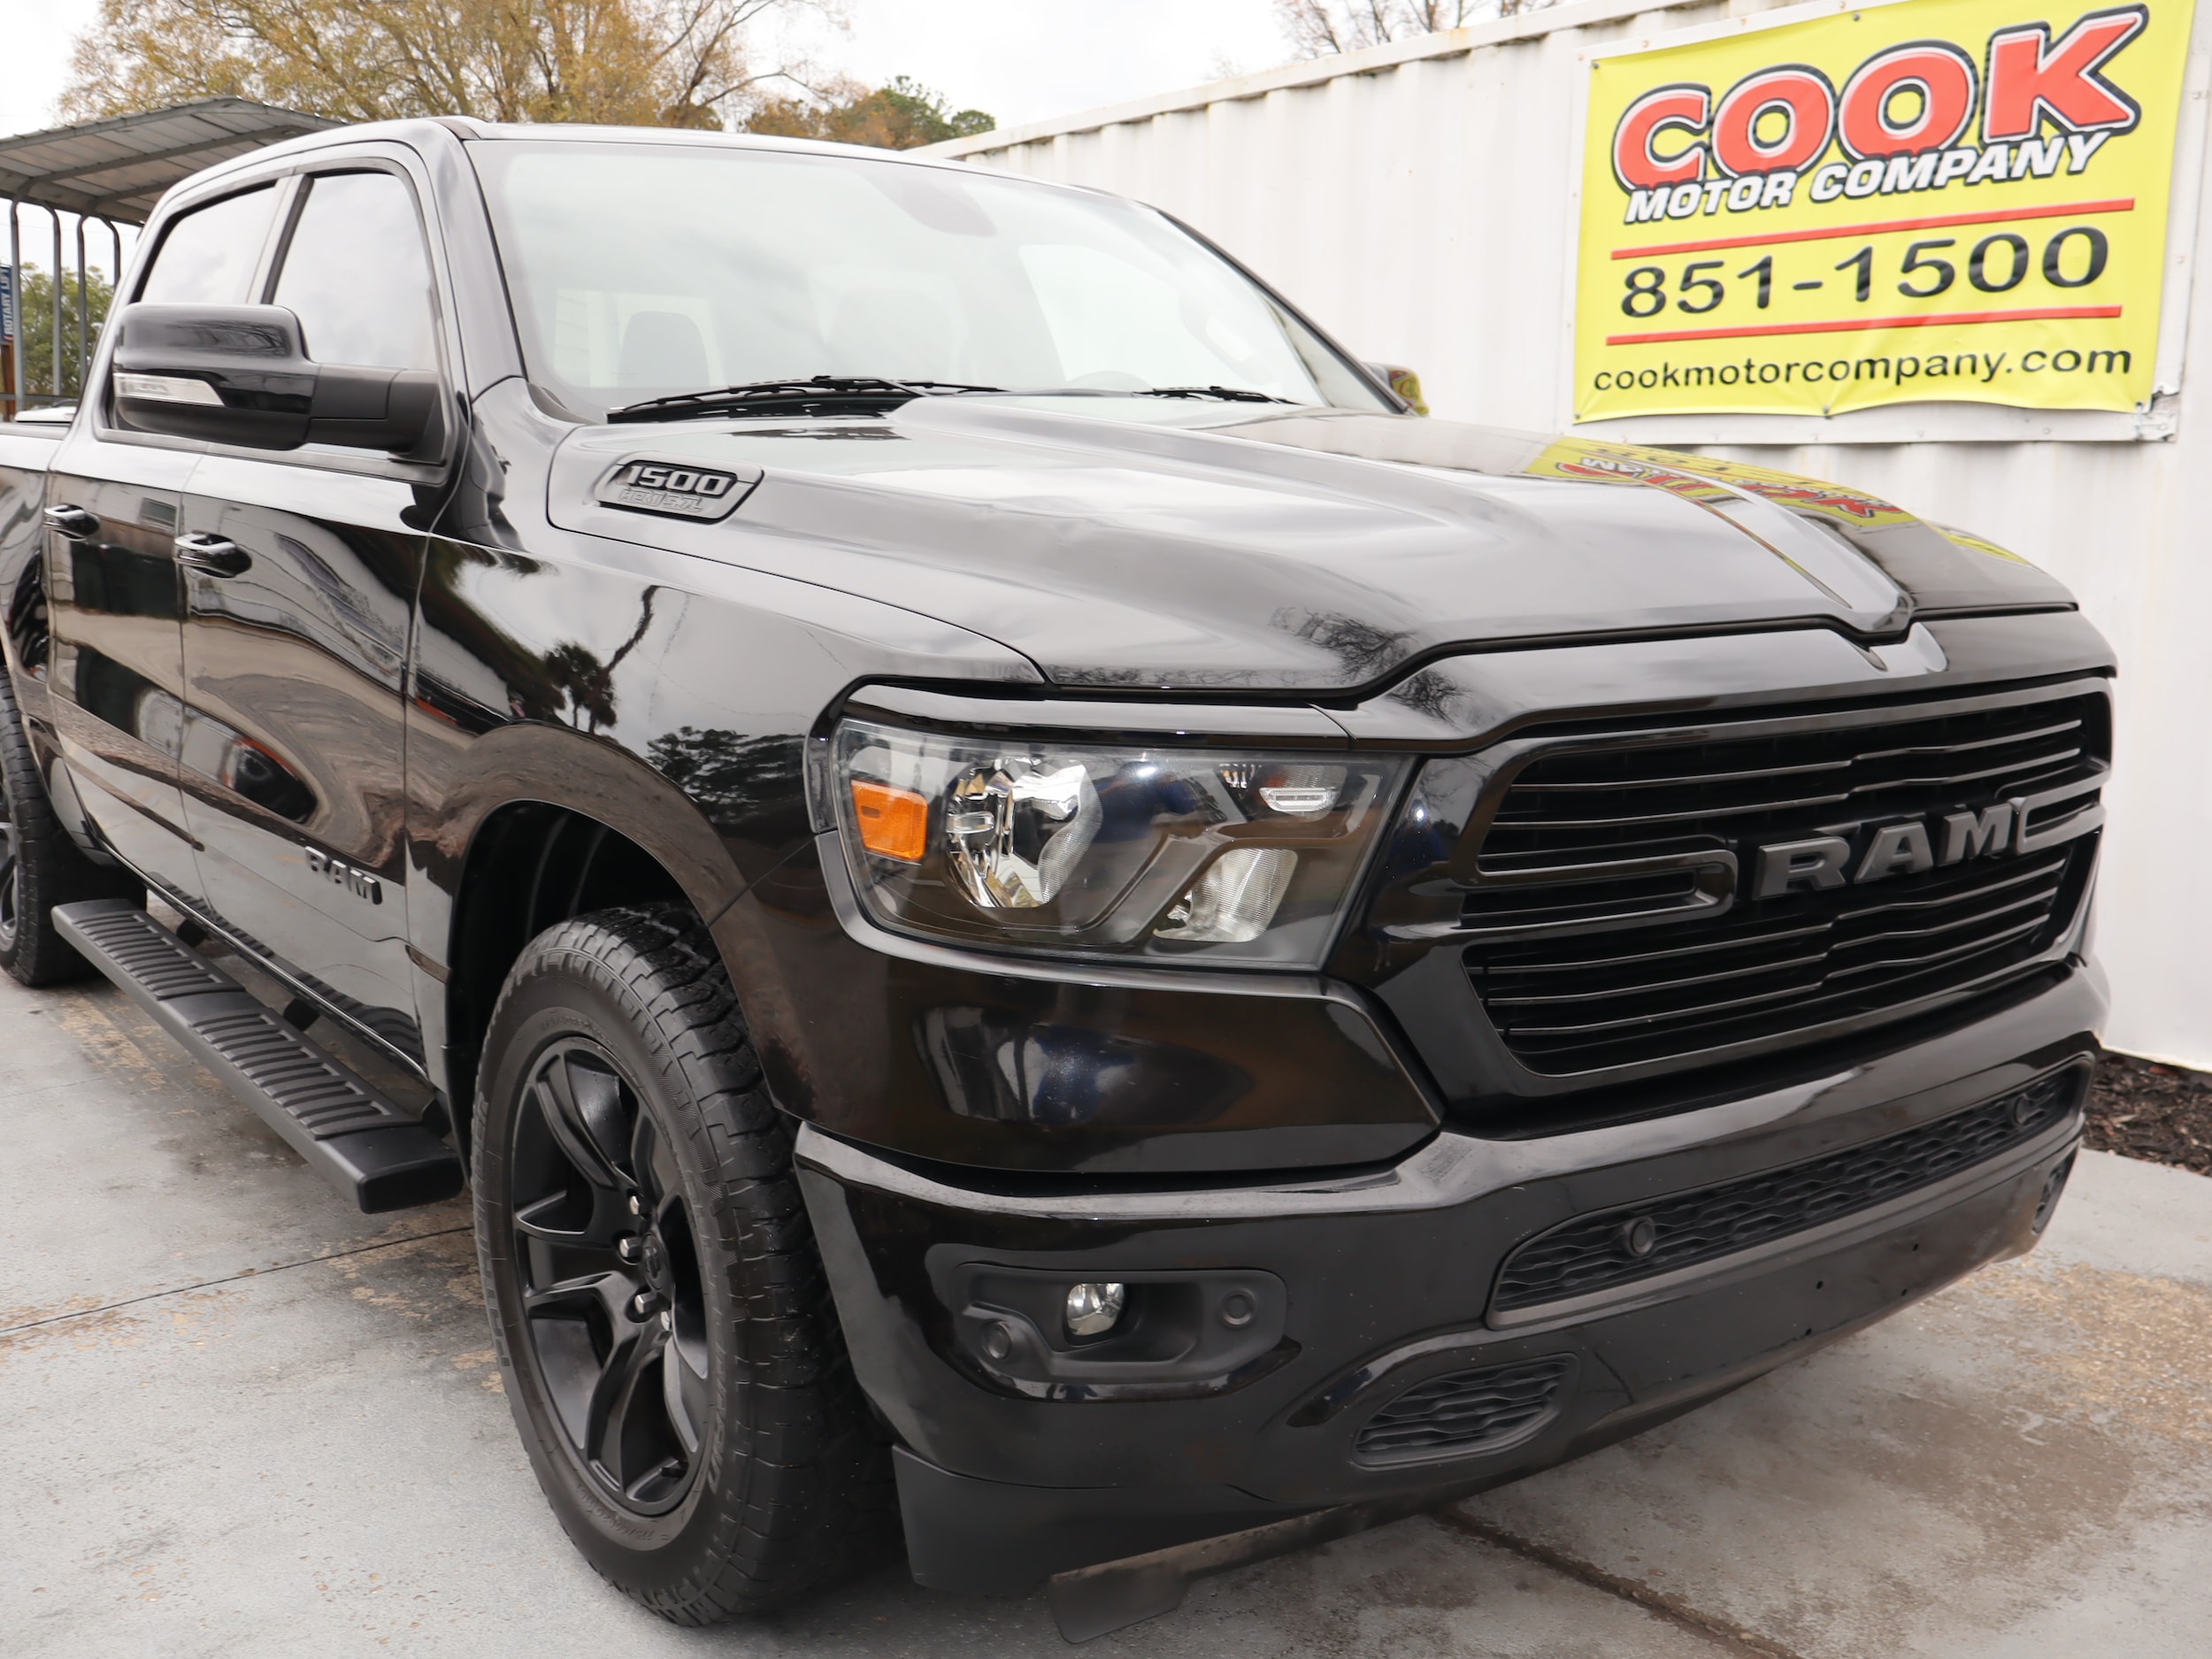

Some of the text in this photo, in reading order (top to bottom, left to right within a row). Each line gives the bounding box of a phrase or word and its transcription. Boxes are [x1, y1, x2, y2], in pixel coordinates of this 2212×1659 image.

[1613, 4, 2149, 193] COOK
[1625, 131, 2111, 224] MOTOR COMPANY
[1620, 227, 2109, 318] 851-1500
[1, 293, 14, 334] ROTARY
[1594, 348, 2132, 391] cookmotorcompany.com
[618, 488, 666, 507] HEMI
[624, 465, 732, 496] 1500
[304, 845, 382, 905] RAM
[1753, 803, 2012, 901] RAM
